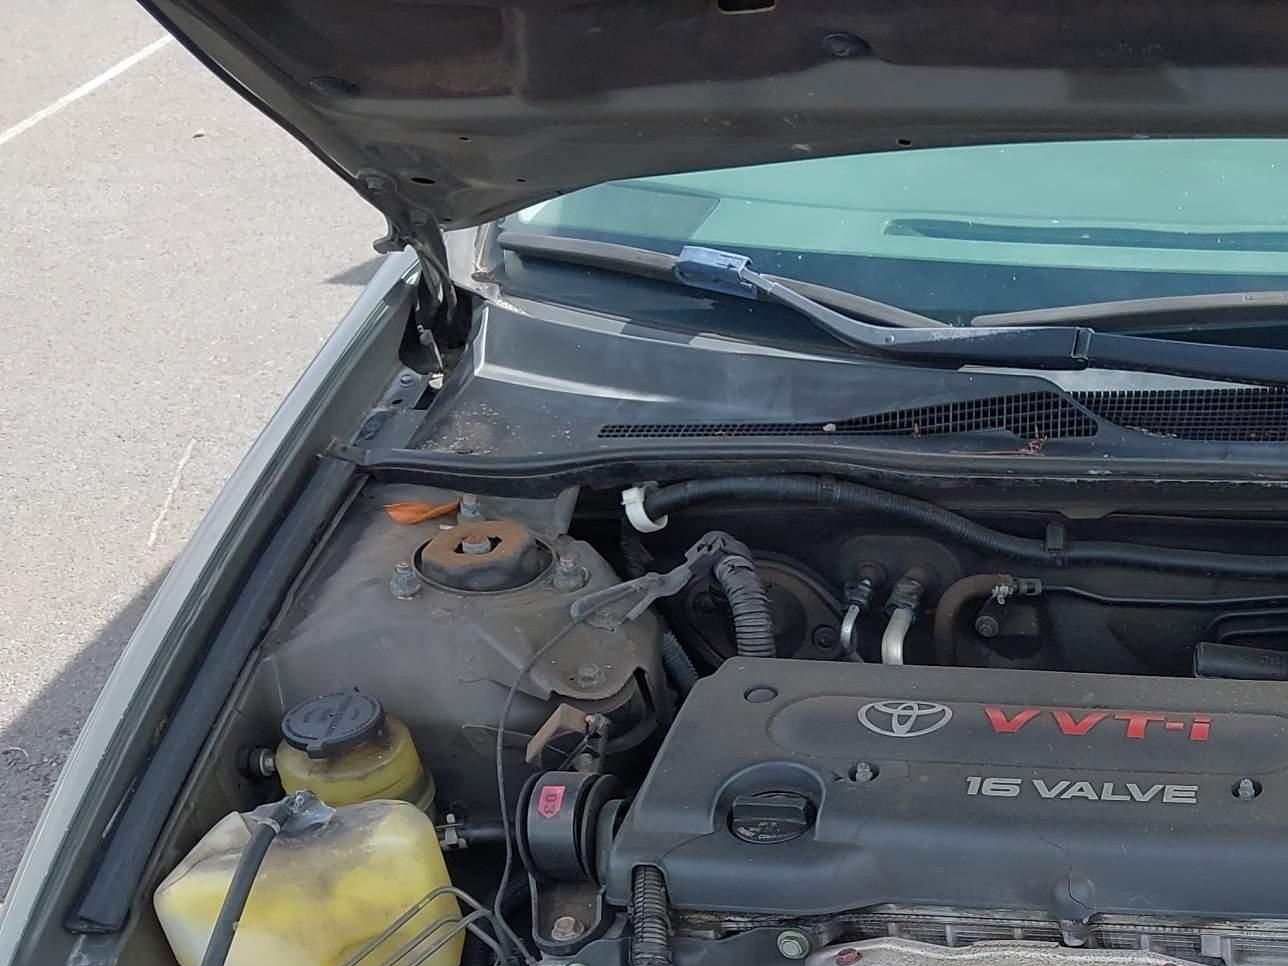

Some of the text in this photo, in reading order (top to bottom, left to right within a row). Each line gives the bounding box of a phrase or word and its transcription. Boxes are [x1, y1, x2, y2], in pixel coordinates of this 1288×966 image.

[984, 707, 1212, 741] VVT-i
[966, 776, 1199, 803] 16 VALVE
